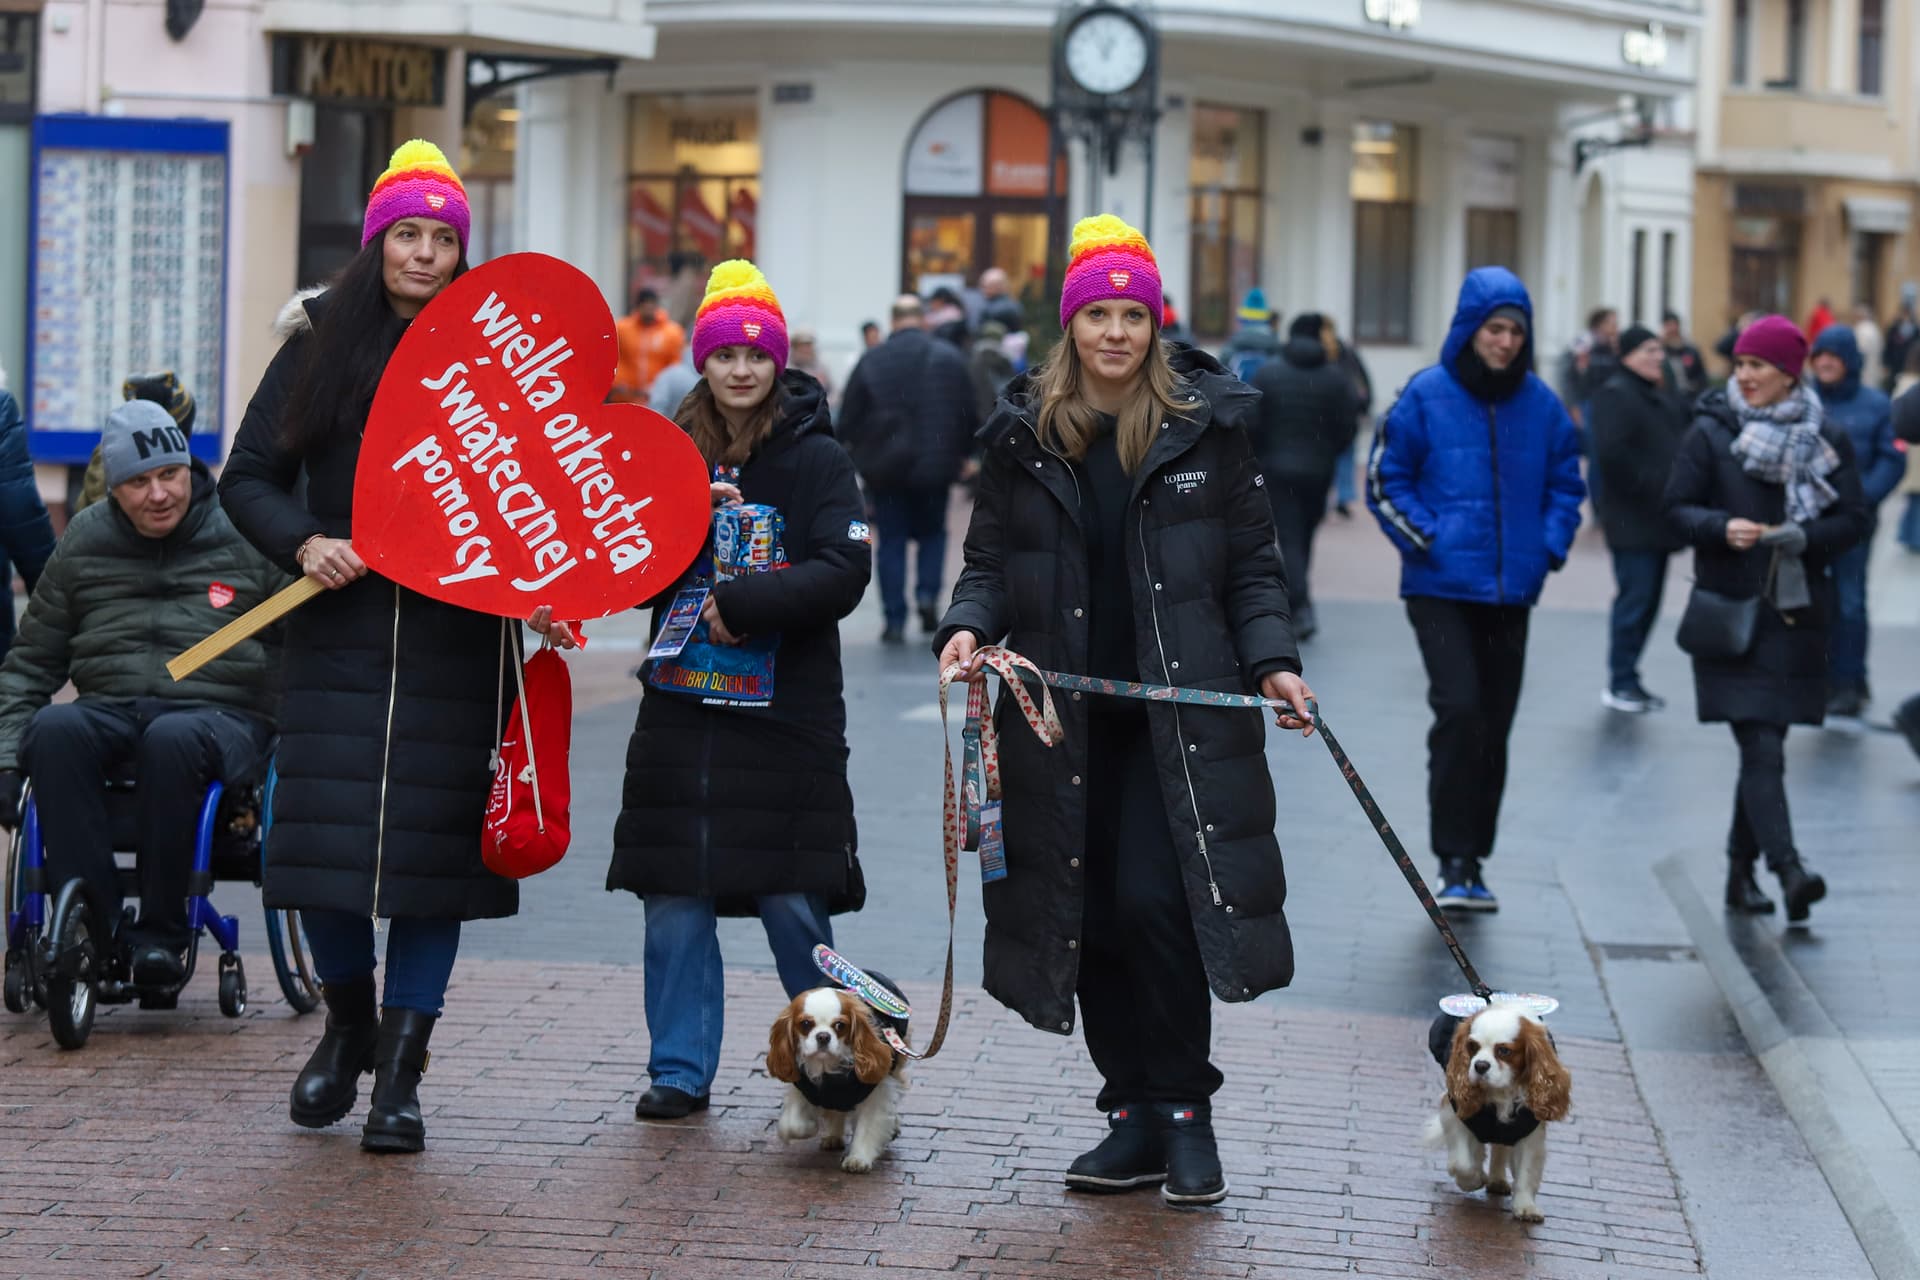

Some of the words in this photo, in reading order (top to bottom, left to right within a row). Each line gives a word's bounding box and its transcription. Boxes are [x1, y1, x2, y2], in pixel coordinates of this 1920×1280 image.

[302, 38, 433, 102] KANTOR
[471, 291, 574, 413] wielka
[543, 412, 653, 575] orkiestra
[420, 356, 597, 592] świątecznej
[1163, 471, 1207, 484] tommy
[1176, 481, 1198, 493] jeans
[391, 434, 500, 586] pomocy
[672, 666, 710, 688] DOBRY
[827, 954, 868, 986] orkiestra
[868, 983, 900, 1009] wielka
